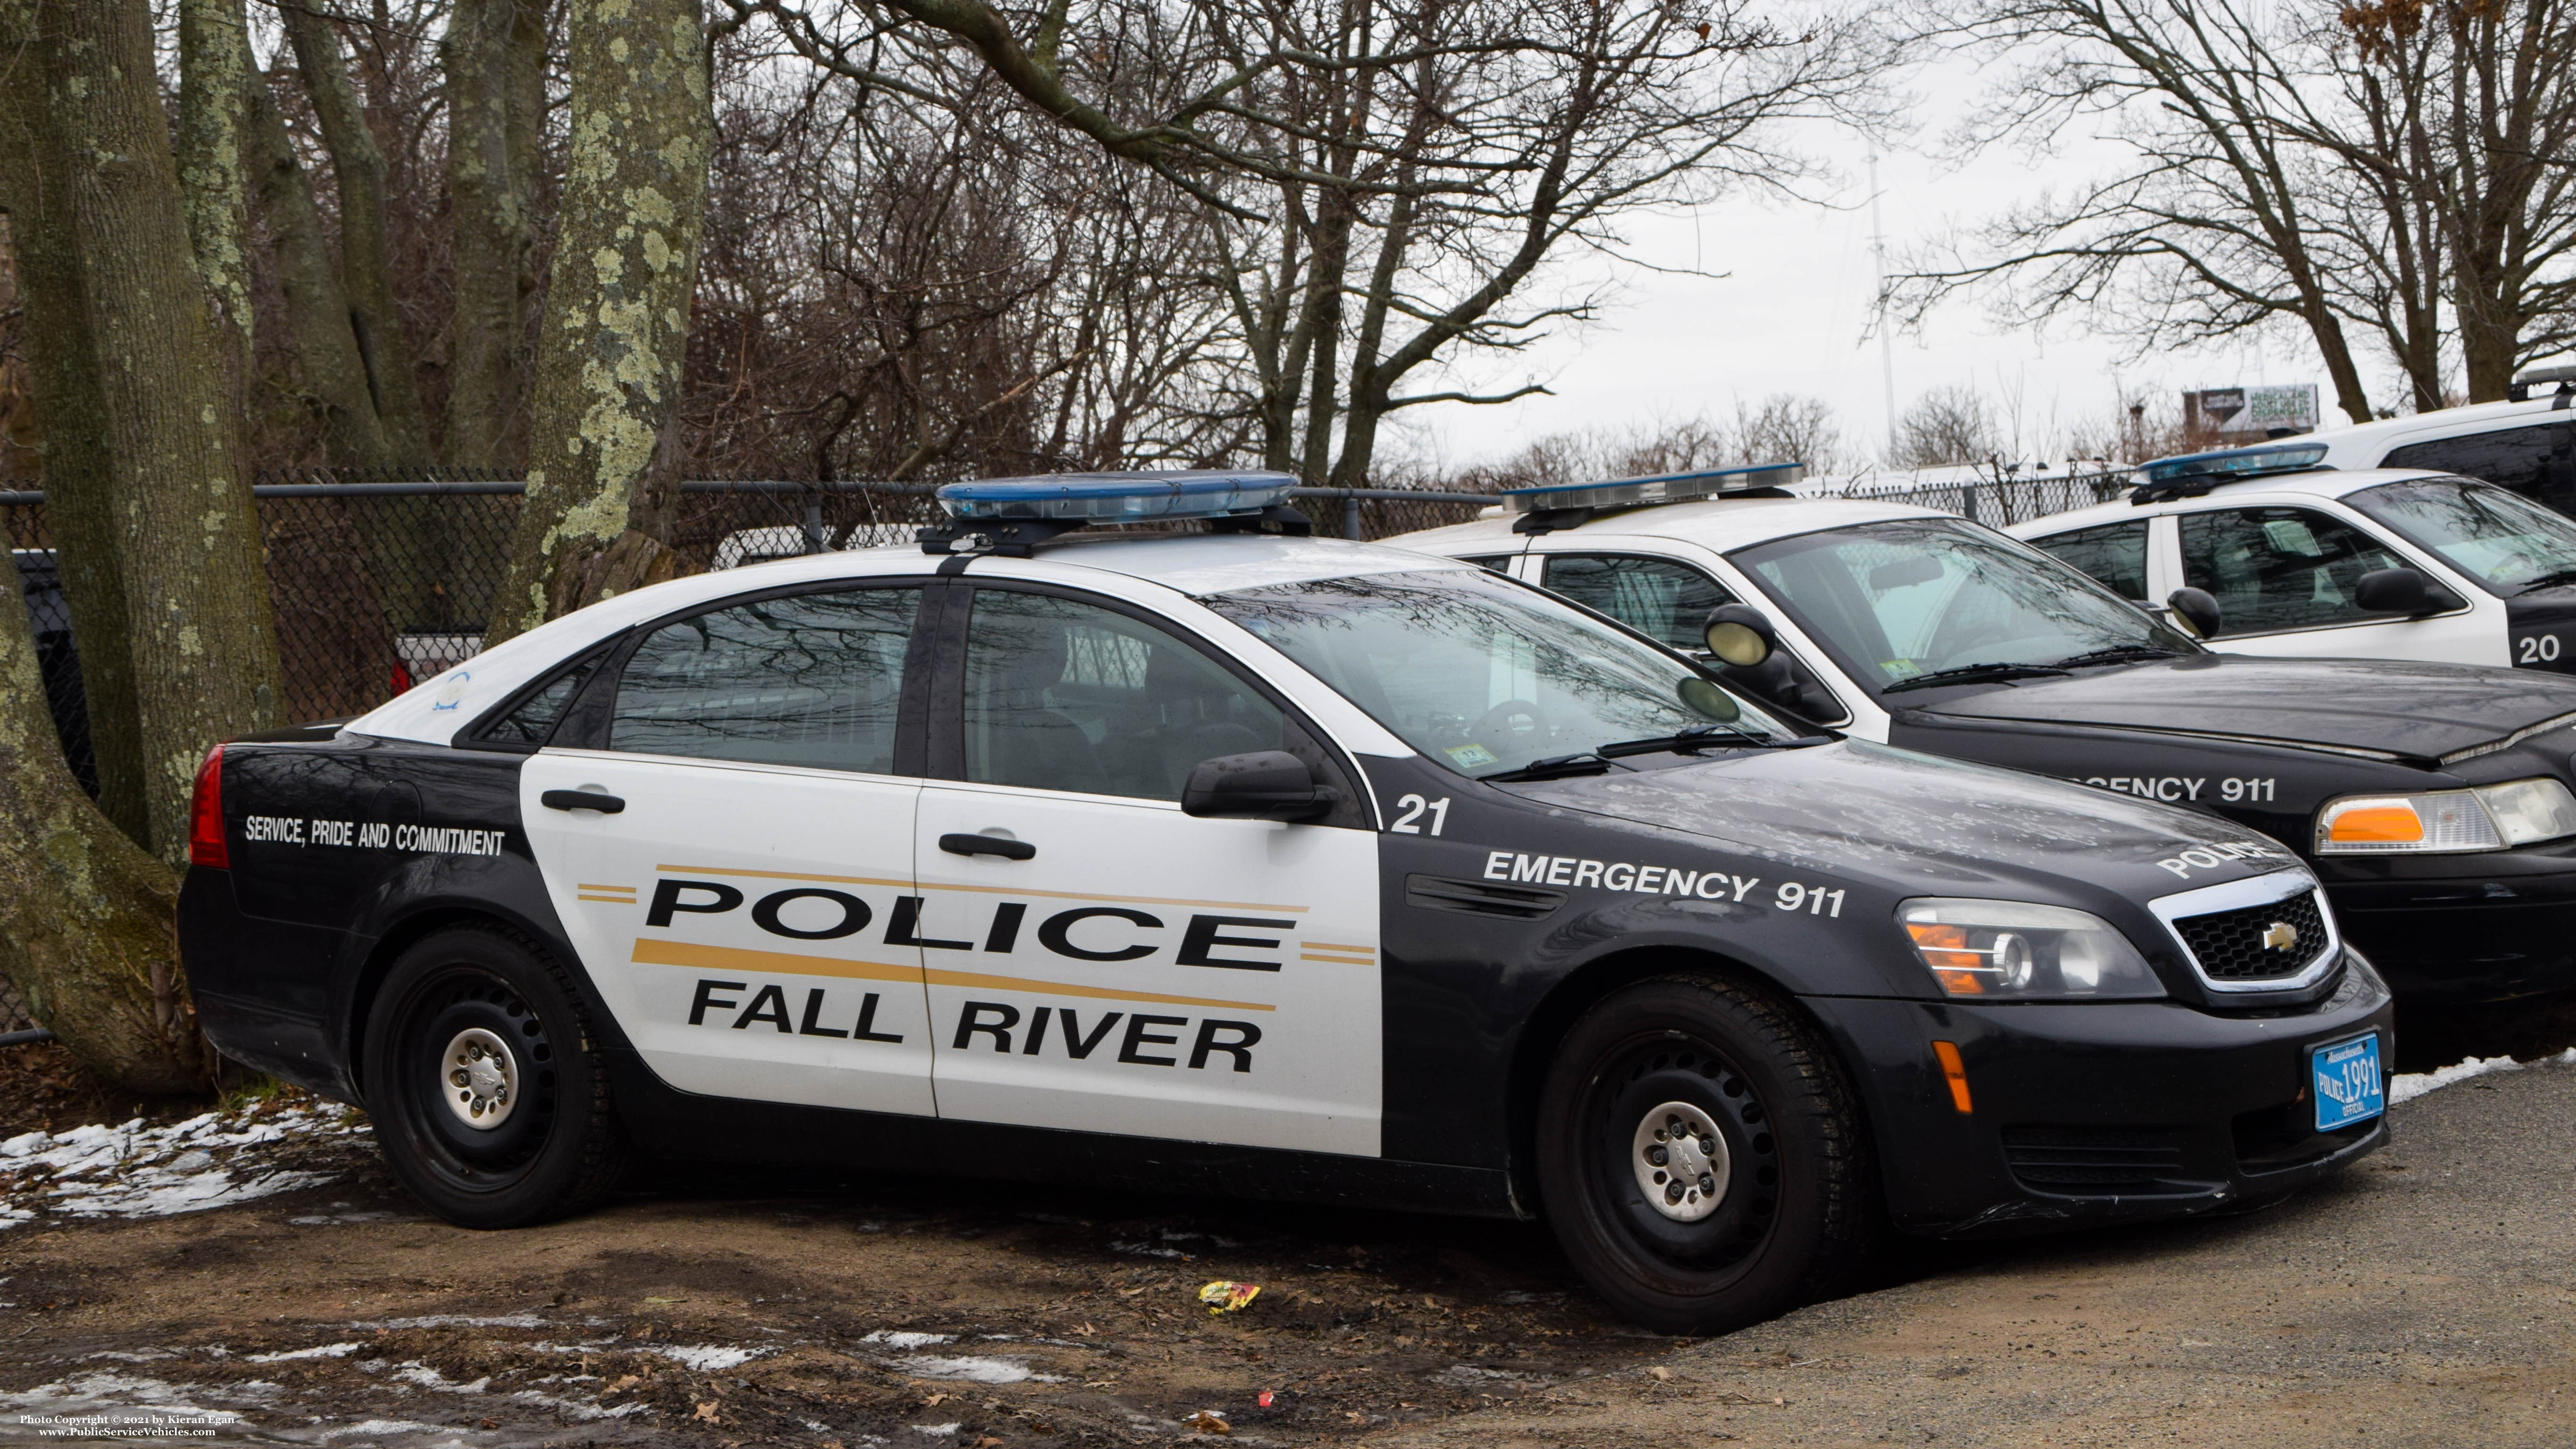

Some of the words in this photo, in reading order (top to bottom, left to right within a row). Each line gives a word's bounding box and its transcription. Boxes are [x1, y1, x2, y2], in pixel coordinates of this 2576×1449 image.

[2520, 635, 2559, 664] 20
[2222, 778, 2275, 801] 911
[1391, 794, 1450, 836] 21
[246, 816, 305, 848] SERVICE,
[311, 820, 353, 847] PRIDE
[358, 824, 390, 848] AND
[396, 824, 505, 856] COMMITMENT
[2156, 842, 2280, 879] POLICE
[1484, 851, 1759, 902] EMERGENCY
[1775, 882, 1845, 918] 911
[646, 879, 1297, 972] POLICE
[688, 979, 904, 1044] FALL
[953, 1000, 1262, 1073] RIVER
[2327, 1044, 2364, 1064] Massachusetts
[2318, 1071, 2345, 1104] POLICE
[2342, 1056, 2380, 1104] 1991
[2343, 1101, 2365, 1117] OFFICIAL
